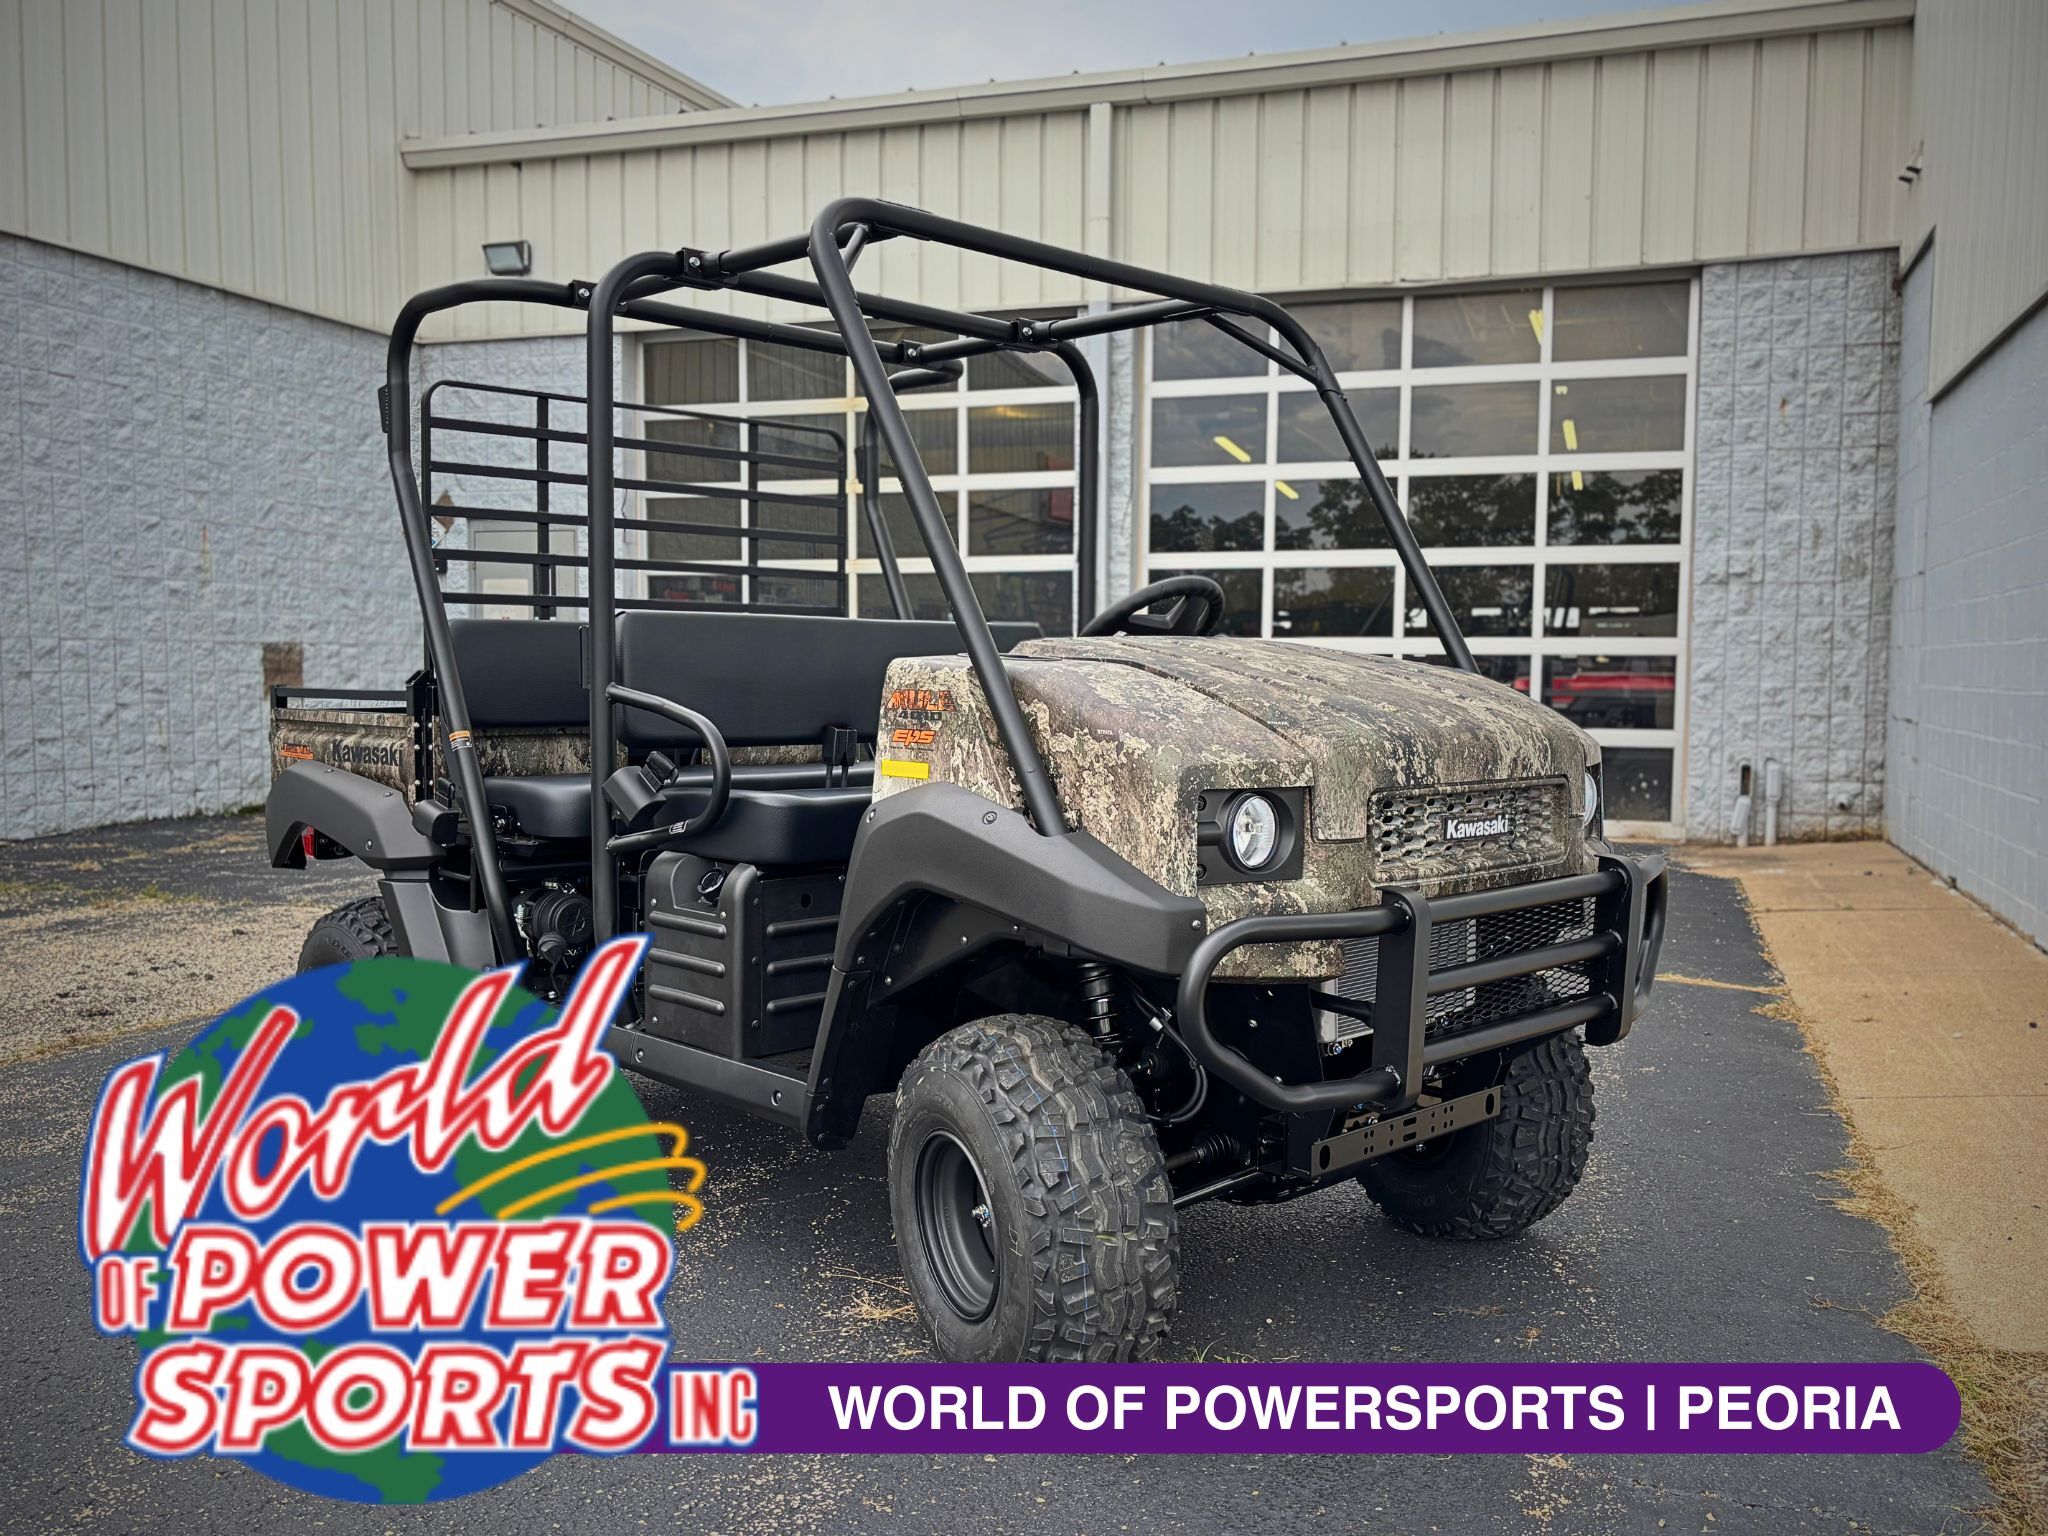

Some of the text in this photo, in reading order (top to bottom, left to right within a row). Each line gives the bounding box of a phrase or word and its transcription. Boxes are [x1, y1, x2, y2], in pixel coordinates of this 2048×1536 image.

[885, 689, 958, 712] MULE
[332, 739, 404, 767] Kawasaki
[1446, 813, 1509, 840] Kawasaki
